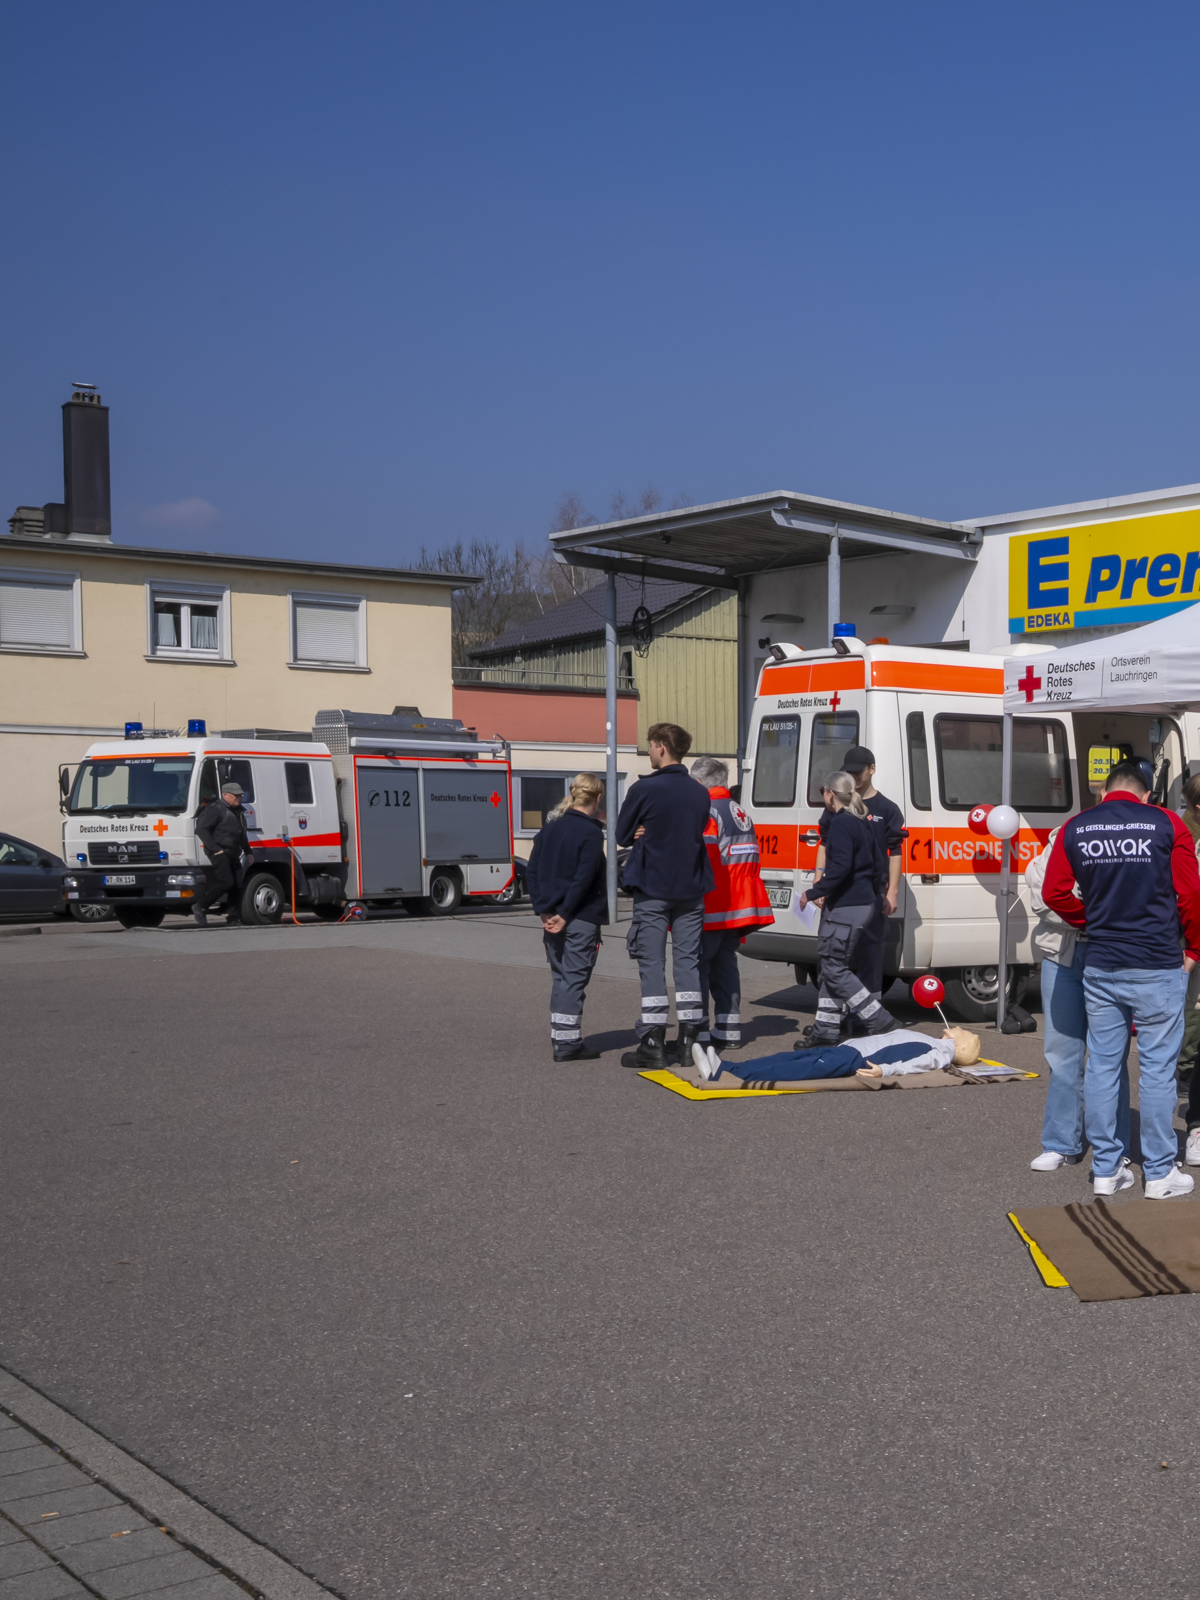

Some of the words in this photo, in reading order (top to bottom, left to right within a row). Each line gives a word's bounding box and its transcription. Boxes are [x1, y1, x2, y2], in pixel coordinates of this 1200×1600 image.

[1027, 536, 1070, 610] E
[1027, 612, 1071, 629] EDEKA
[1047, 660, 1096, 675] Deutsches
[1110, 655, 1151, 668] Ortsverein
[1047, 676, 1073, 688] Rotes
[1110, 669, 1158, 683] Lauchringen
[1046, 689, 1073, 701] Kreuz
[777, 699, 799, 709] Deutsches
[800, 698, 813, 707] Rotes
[813, 697, 828, 706] Kreuz
[384, 790, 411, 807] 112
[431, 793, 456, 801] Deutsches
[458, 794, 472, 802] Rotes
[80, 824, 109, 833] Deutsches
[111, 824, 128, 832] Rotes
[130, 823, 149, 831] Kreuz
[107, 845, 138, 853] MAN
[760, 835, 778, 854] 112
